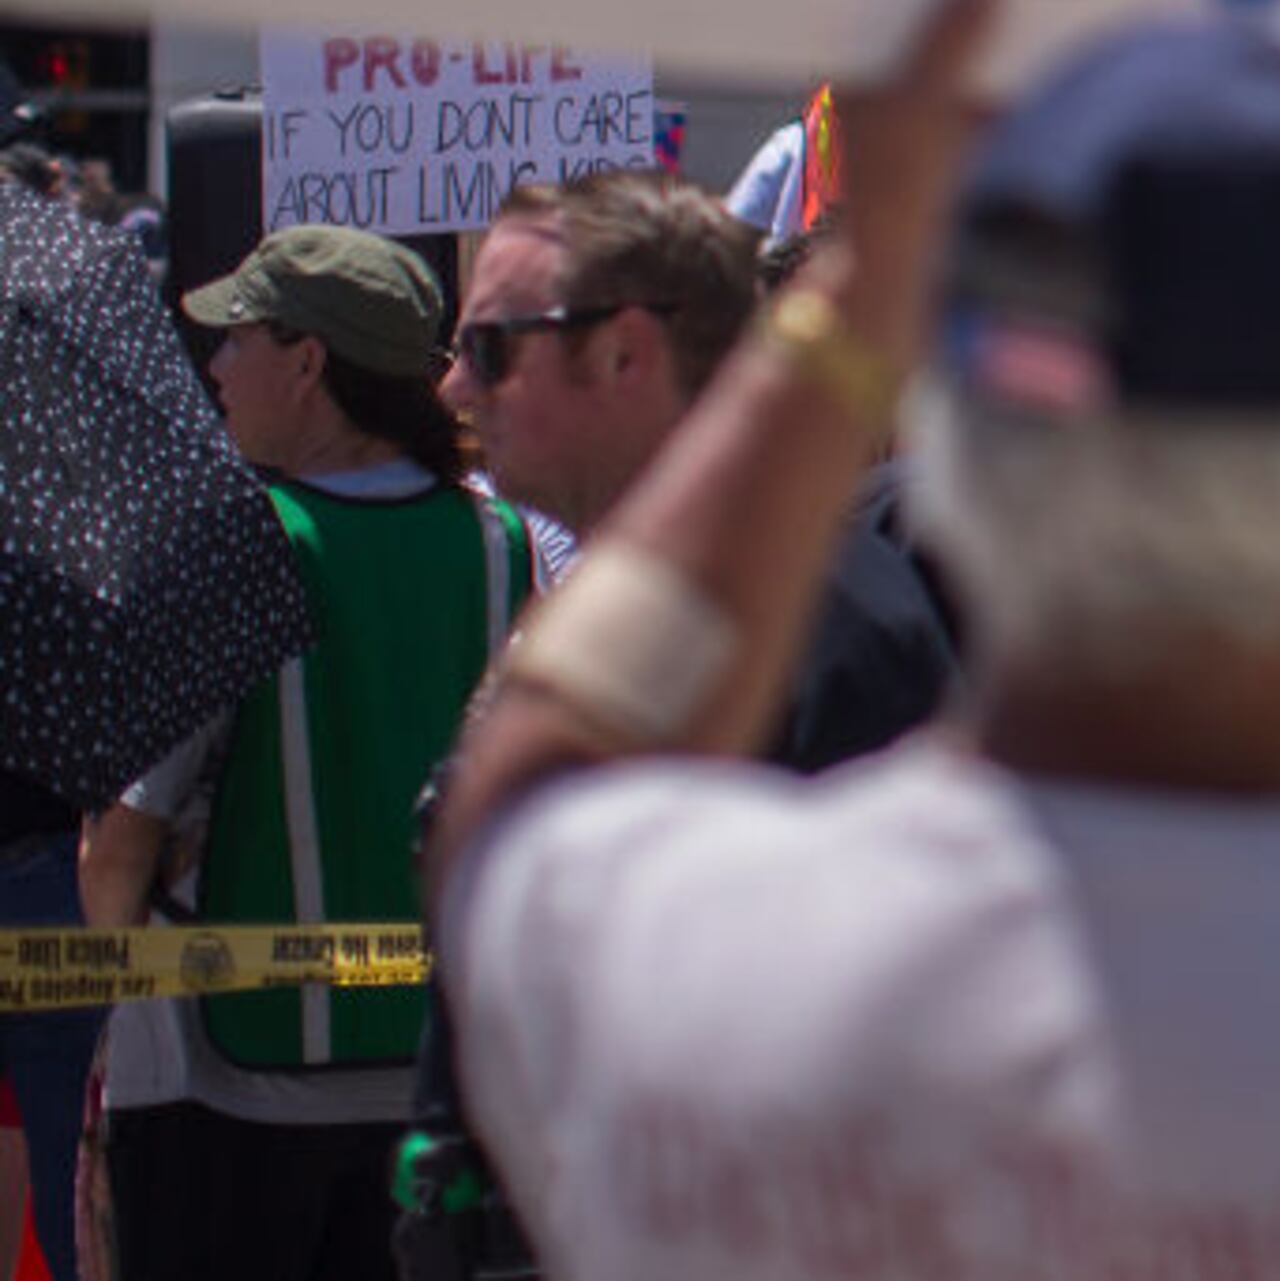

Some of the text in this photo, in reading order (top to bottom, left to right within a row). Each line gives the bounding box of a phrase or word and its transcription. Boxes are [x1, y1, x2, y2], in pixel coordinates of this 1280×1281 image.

[268, 89, 651, 162] IF YOU DONT CARE
[271, 168, 396, 230] ABOUT
